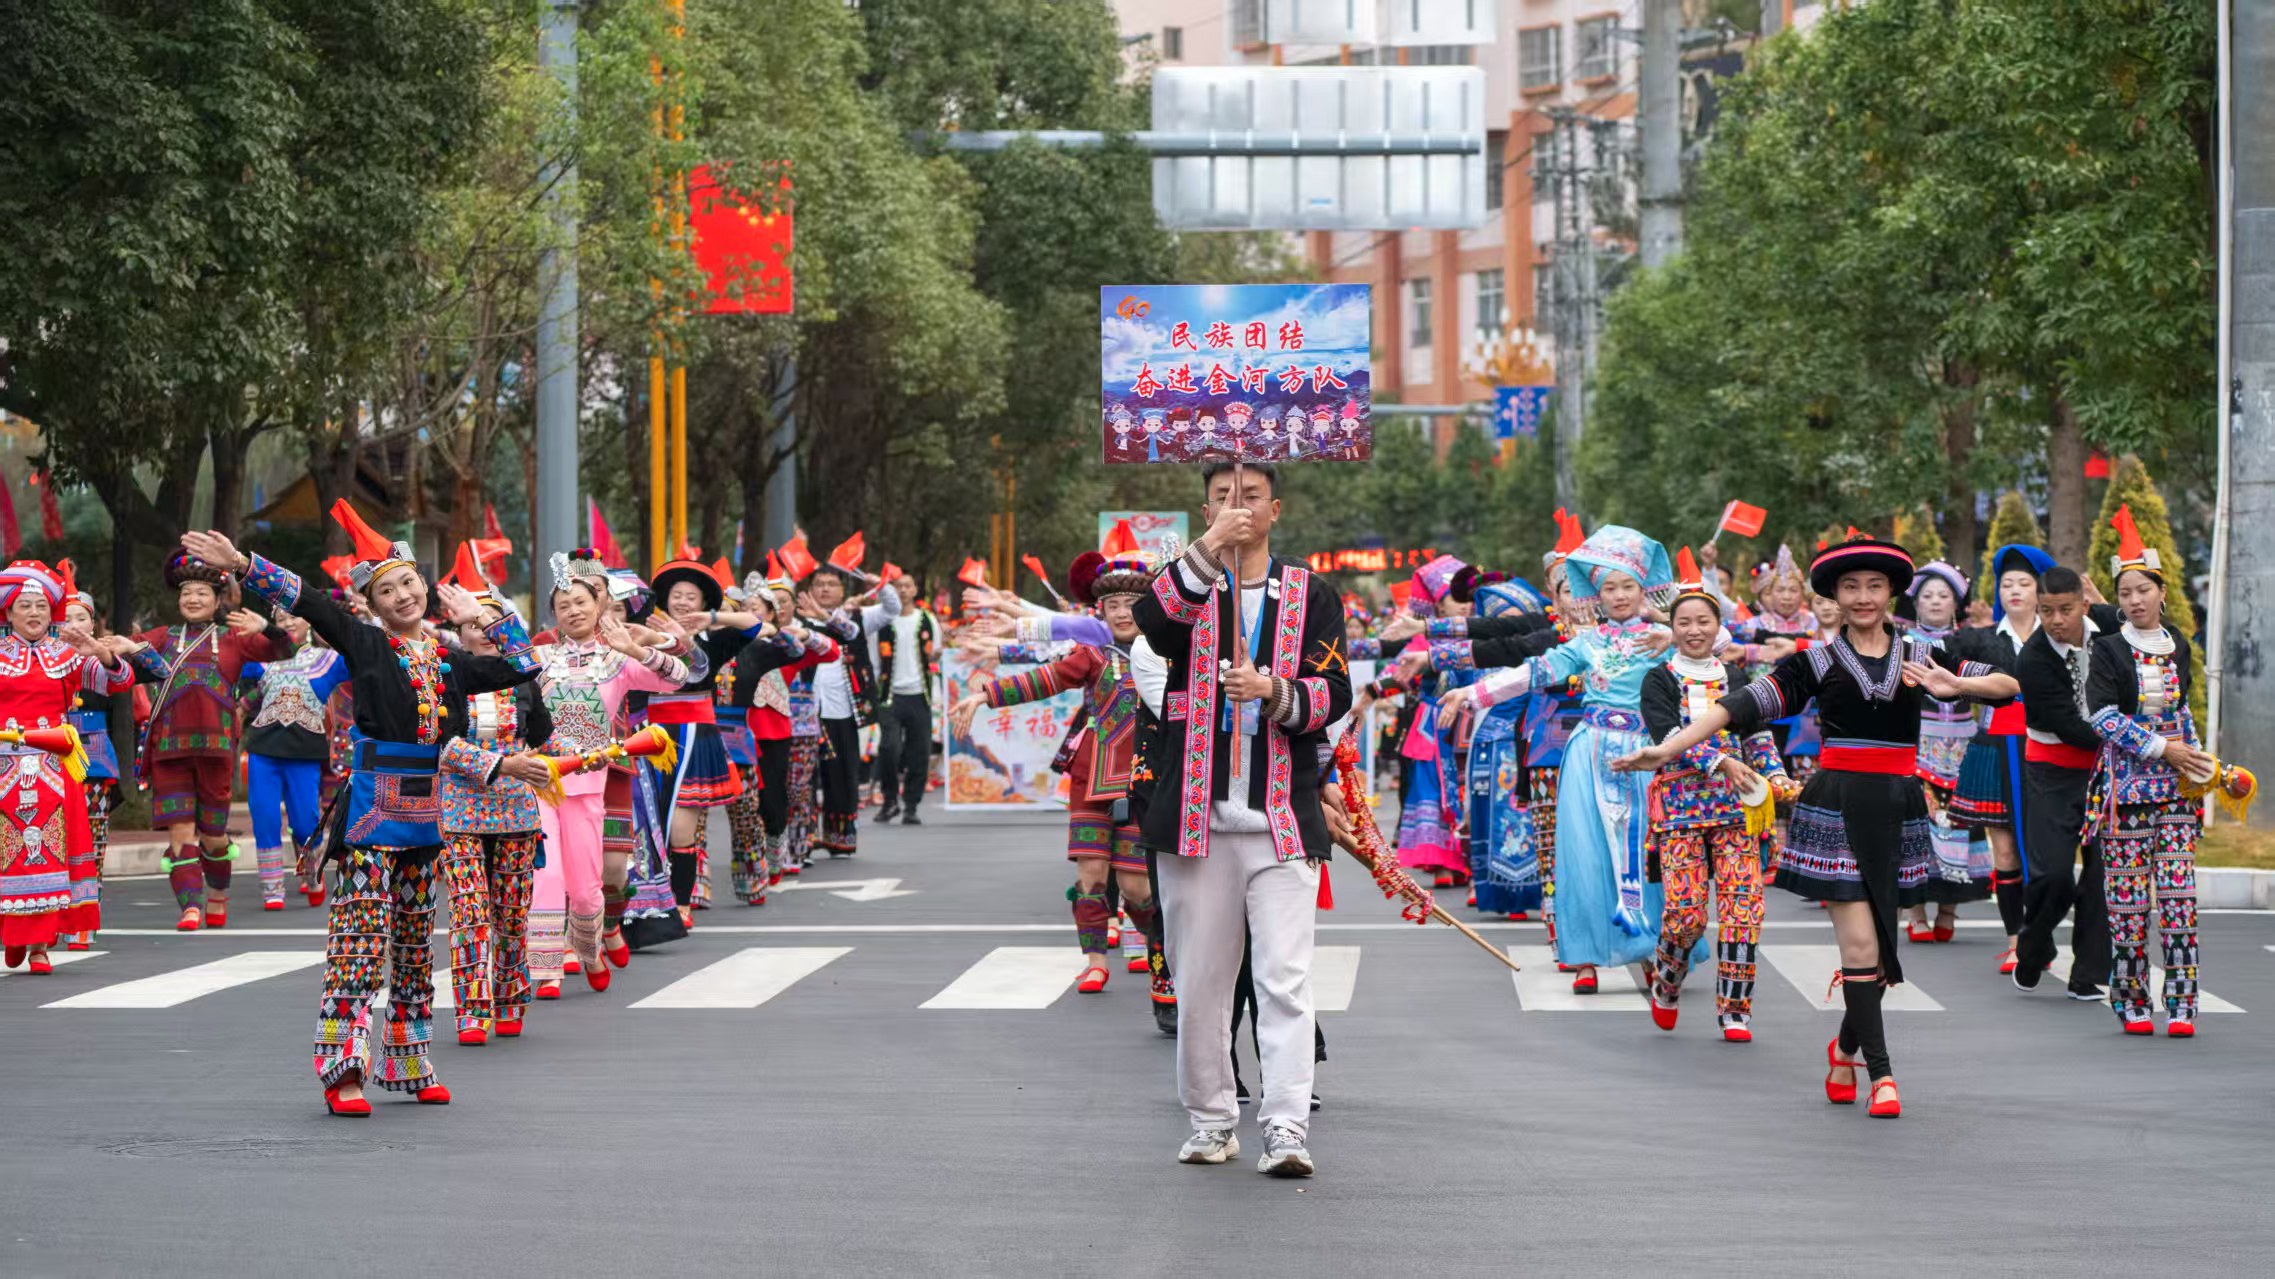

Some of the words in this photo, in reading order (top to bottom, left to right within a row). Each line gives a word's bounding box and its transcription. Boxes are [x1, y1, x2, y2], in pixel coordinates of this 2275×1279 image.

[1171, 320, 1305, 351] 民族团结
[1130, 362, 1348, 397] 奋进金河方队
